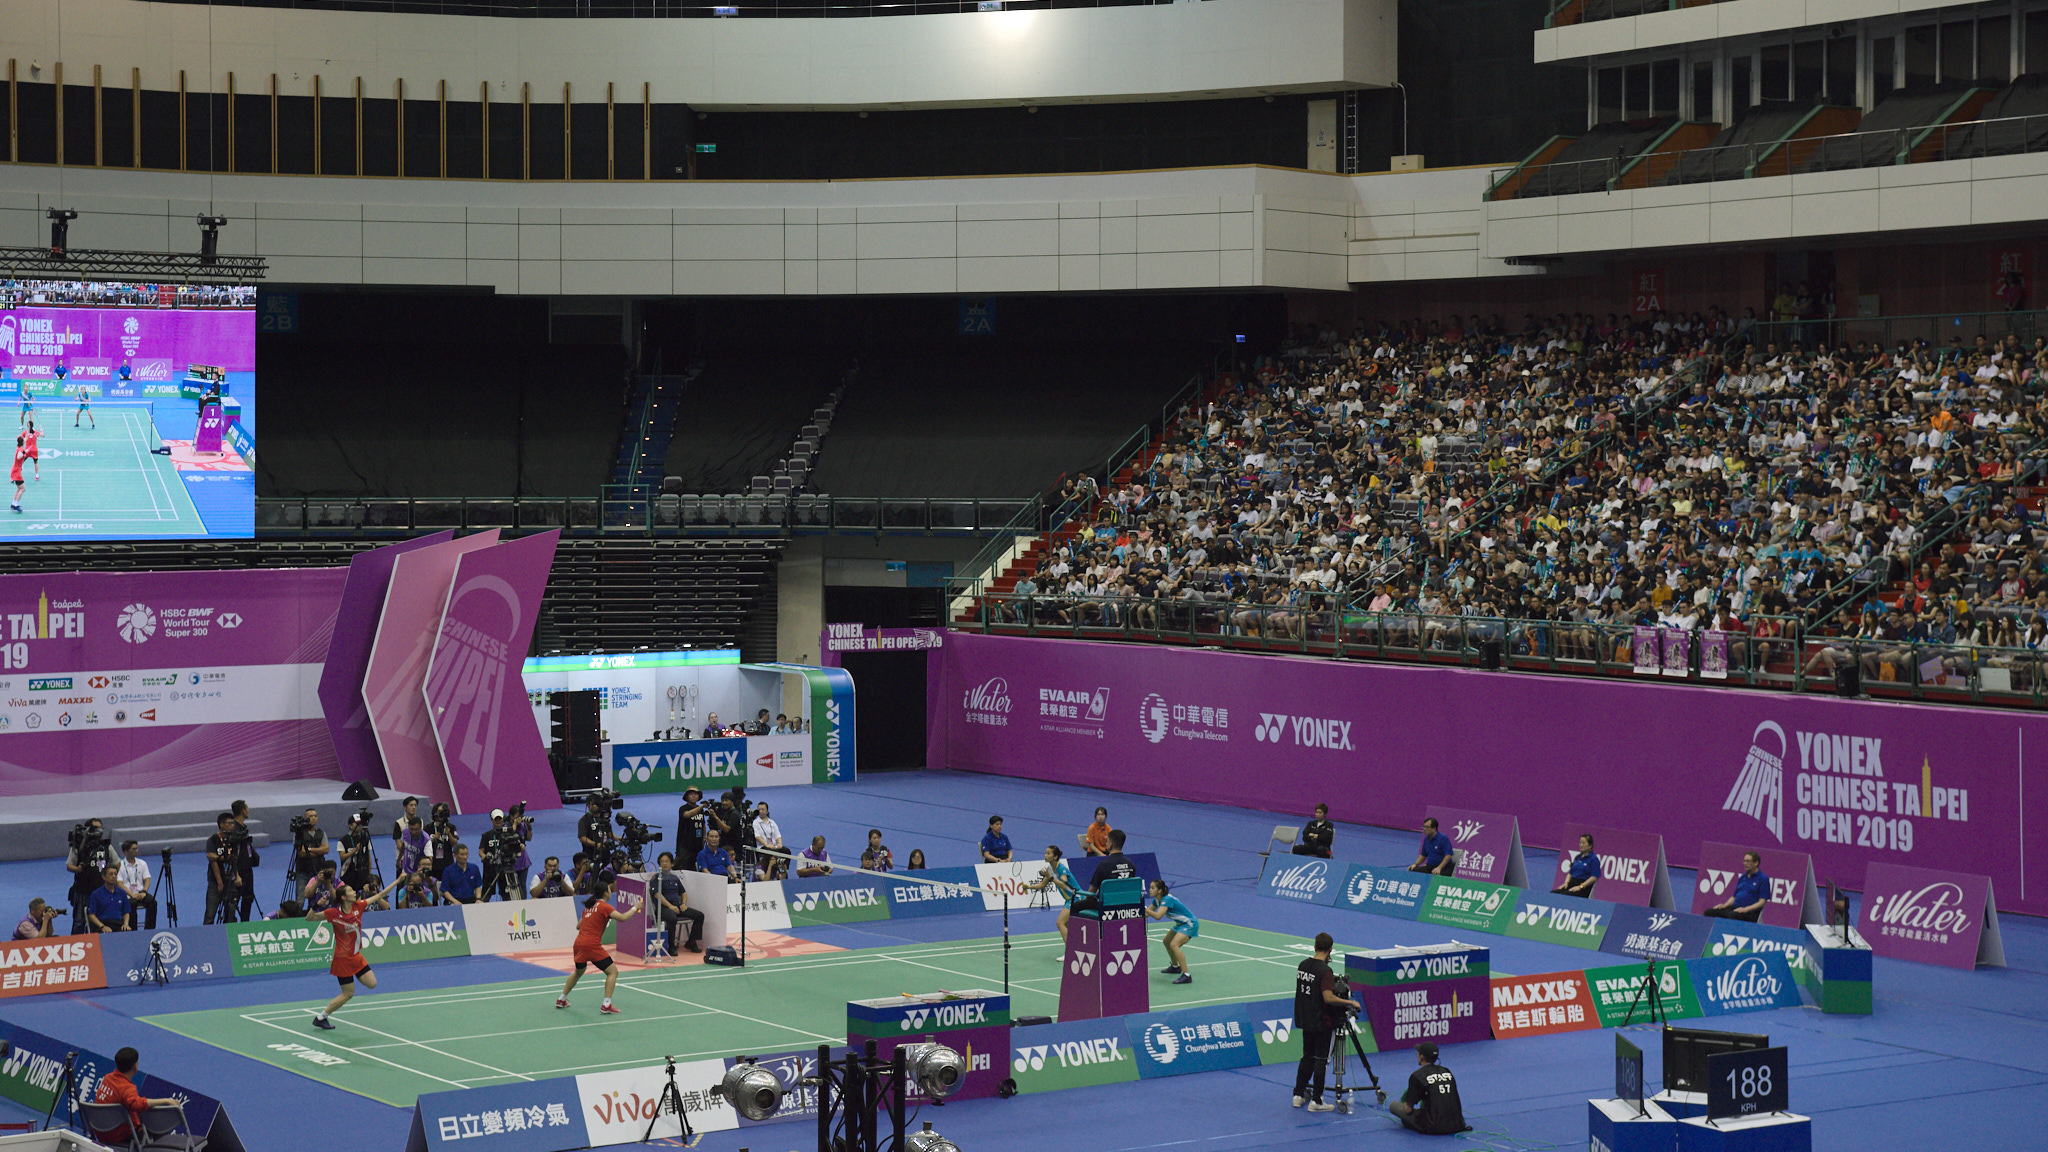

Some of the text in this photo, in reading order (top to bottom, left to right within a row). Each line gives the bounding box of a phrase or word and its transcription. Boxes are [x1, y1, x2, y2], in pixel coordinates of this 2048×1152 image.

[1640, 274, 1657, 292] 紅
[1636, 295, 1660, 311] 2A
[20, 318, 53, 333] YONEX
[262, 315, 291, 330] 2B
[964, 317, 991, 332] 2A
[20, 332, 54, 344] CHINESE
[20, 344, 63, 355] OPEN 2019
[28, 365, 51, 375] YONEX
[86, 366, 109, 376] YONEX
[157, 385, 179, 393] YONEX
[210, 408, 215, 416] 1
[160, 608, 214, 618] HSBC BWF
[163, 618, 210, 627] World Tour
[828, 623, 864, 638] YONEX
[165, 627, 208, 638] Super 300
[442, 616, 508, 663] CHINESE
[828, 638, 865, 651] CHINESE
[0, 642, 29, 669] 19
[606, 655, 635, 668] YONEX
[45, 680, 71, 689] YONEX
[611, 686, 631, 694] YONEX
[58, 696, 93, 705] MAXXIS
[611, 692, 643, 701] STRINGING
[963, 677, 1013, 714] iWater
[611, 701, 628, 709] TEAM
[1040, 703, 1078, 719] 長榮航空
[1173, 704, 1228, 728] 中華電信
[1173, 727, 1228, 742] Chunghwa Telecom
[1291, 715, 1352, 751] YONEX
[826, 730, 841, 777] YONEX
[1749, 744, 1783, 771] CHINESE
[1796, 731, 1884, 777] YONEX
[665, 750, 739, 780] YONEX
[1722, 754, 1783, 845] TAIPEI
[1796, 772, 1888, 814] CHINESE
[1797, 808, 1913, 853] OPEN 2019
[1457, 849, 1496, 873] 基金會
[1271, 860, 1328, 894] iWater
[1458, 869, 1491, 879] FOUNDATION
[1376, 878, 1422, 899] 中華電信
[823, 887, 878, 909] YONEX
[1372, 894, 1415, 907] Chunghwa Telecom
[1432, 896, 1472, 912] 長榮航空
[1116, 908, 1141, 919] YONEX
[1869, 882, 1971, 934] iWater
[1548, 907, 1602, 936] YONEX
[394, 921, 458, 946] YONEX
[507, 931, 541, 941] TAIPEI
[1080, 925, 1087, 945] 1
[1119, 924, 1128, 945] 1
[1881, 925, 1949, 945] 金字塔能量活水機
[240, 942, 295, 957] 長榮航空
[1624, 933, 1683, 956] 勇源基金會
[265, 959, 295, 967] ALLIANCE
[1424, 955, 1469, 977] YONEX
[0, 964, 89, 990] 吉斯輪胎
[1296, 971, 1316, 983] STAFF
[1707, 957, 1782, 1001] iWater
[1394, 989, 1428, 1007] YONEX
[1492, 979, 1577, 1008] MAXXIS
[933, 1003, 986, 1027] YONEX
[1394, 1005, 1438, 1024] CHINESE
[1497, 1004, 1585, 1031] 瑪吉斯輪胎
[1181, 1021, 1242, 1043] 中華電信
[1394, 1020, 1449, 1040] OPEN 2019
[1052, 1037, 1124, 1068] YONEX
[1185, 1039, 1244, 1054] Chunghwa Telecom
[25, 1052, 66, 1094] YONEX
[1426, 1072, 1453, 1085] STAFF
[1620, 1055, 1636, 1092] 188
[1438, 1084, 1451, 1094] 57
[1726, 1065, 1772, 1100] 188
[1740, 1102, 1757, 1112] KPH
[438, 1103, 570, 1141] 日立變頻冷氣
